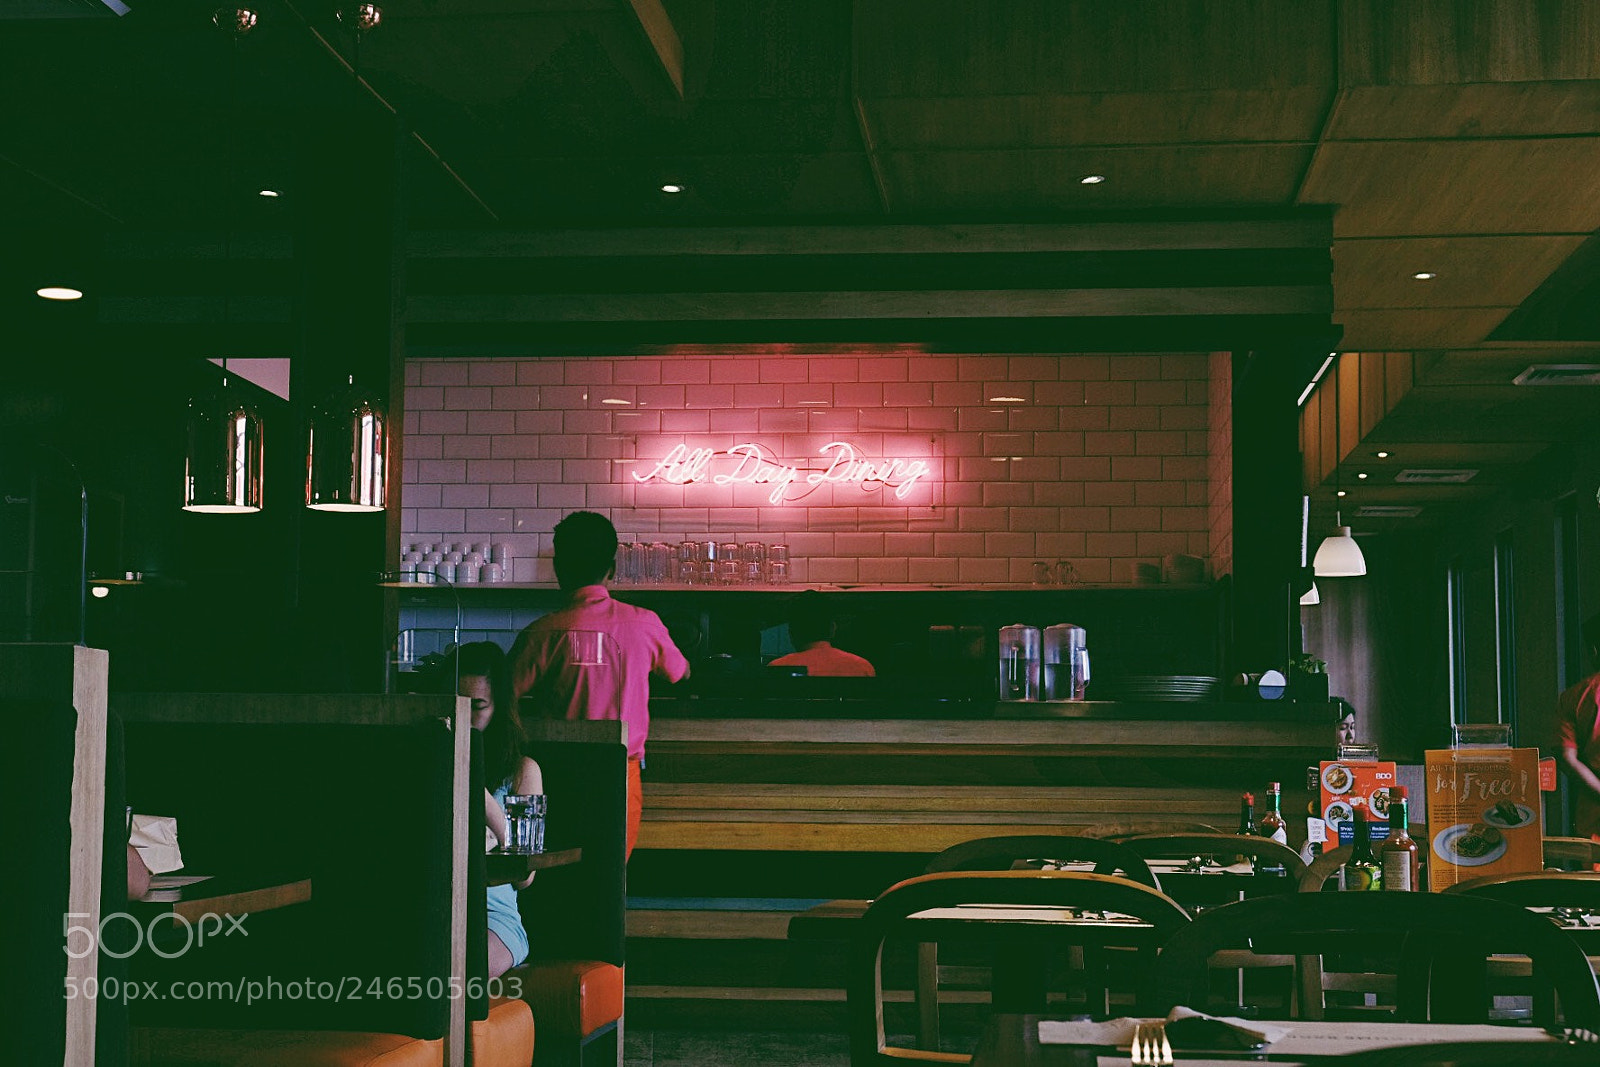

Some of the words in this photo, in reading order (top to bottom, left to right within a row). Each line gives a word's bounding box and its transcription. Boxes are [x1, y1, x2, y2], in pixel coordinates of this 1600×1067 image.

[632, 443, 713, 482] All
[713, 443, 797, 505] Day
[807, 441, 930, 500] Dining
[1434, 773, 1457, 793] for
[1459, 772, 1514, 803] Free
